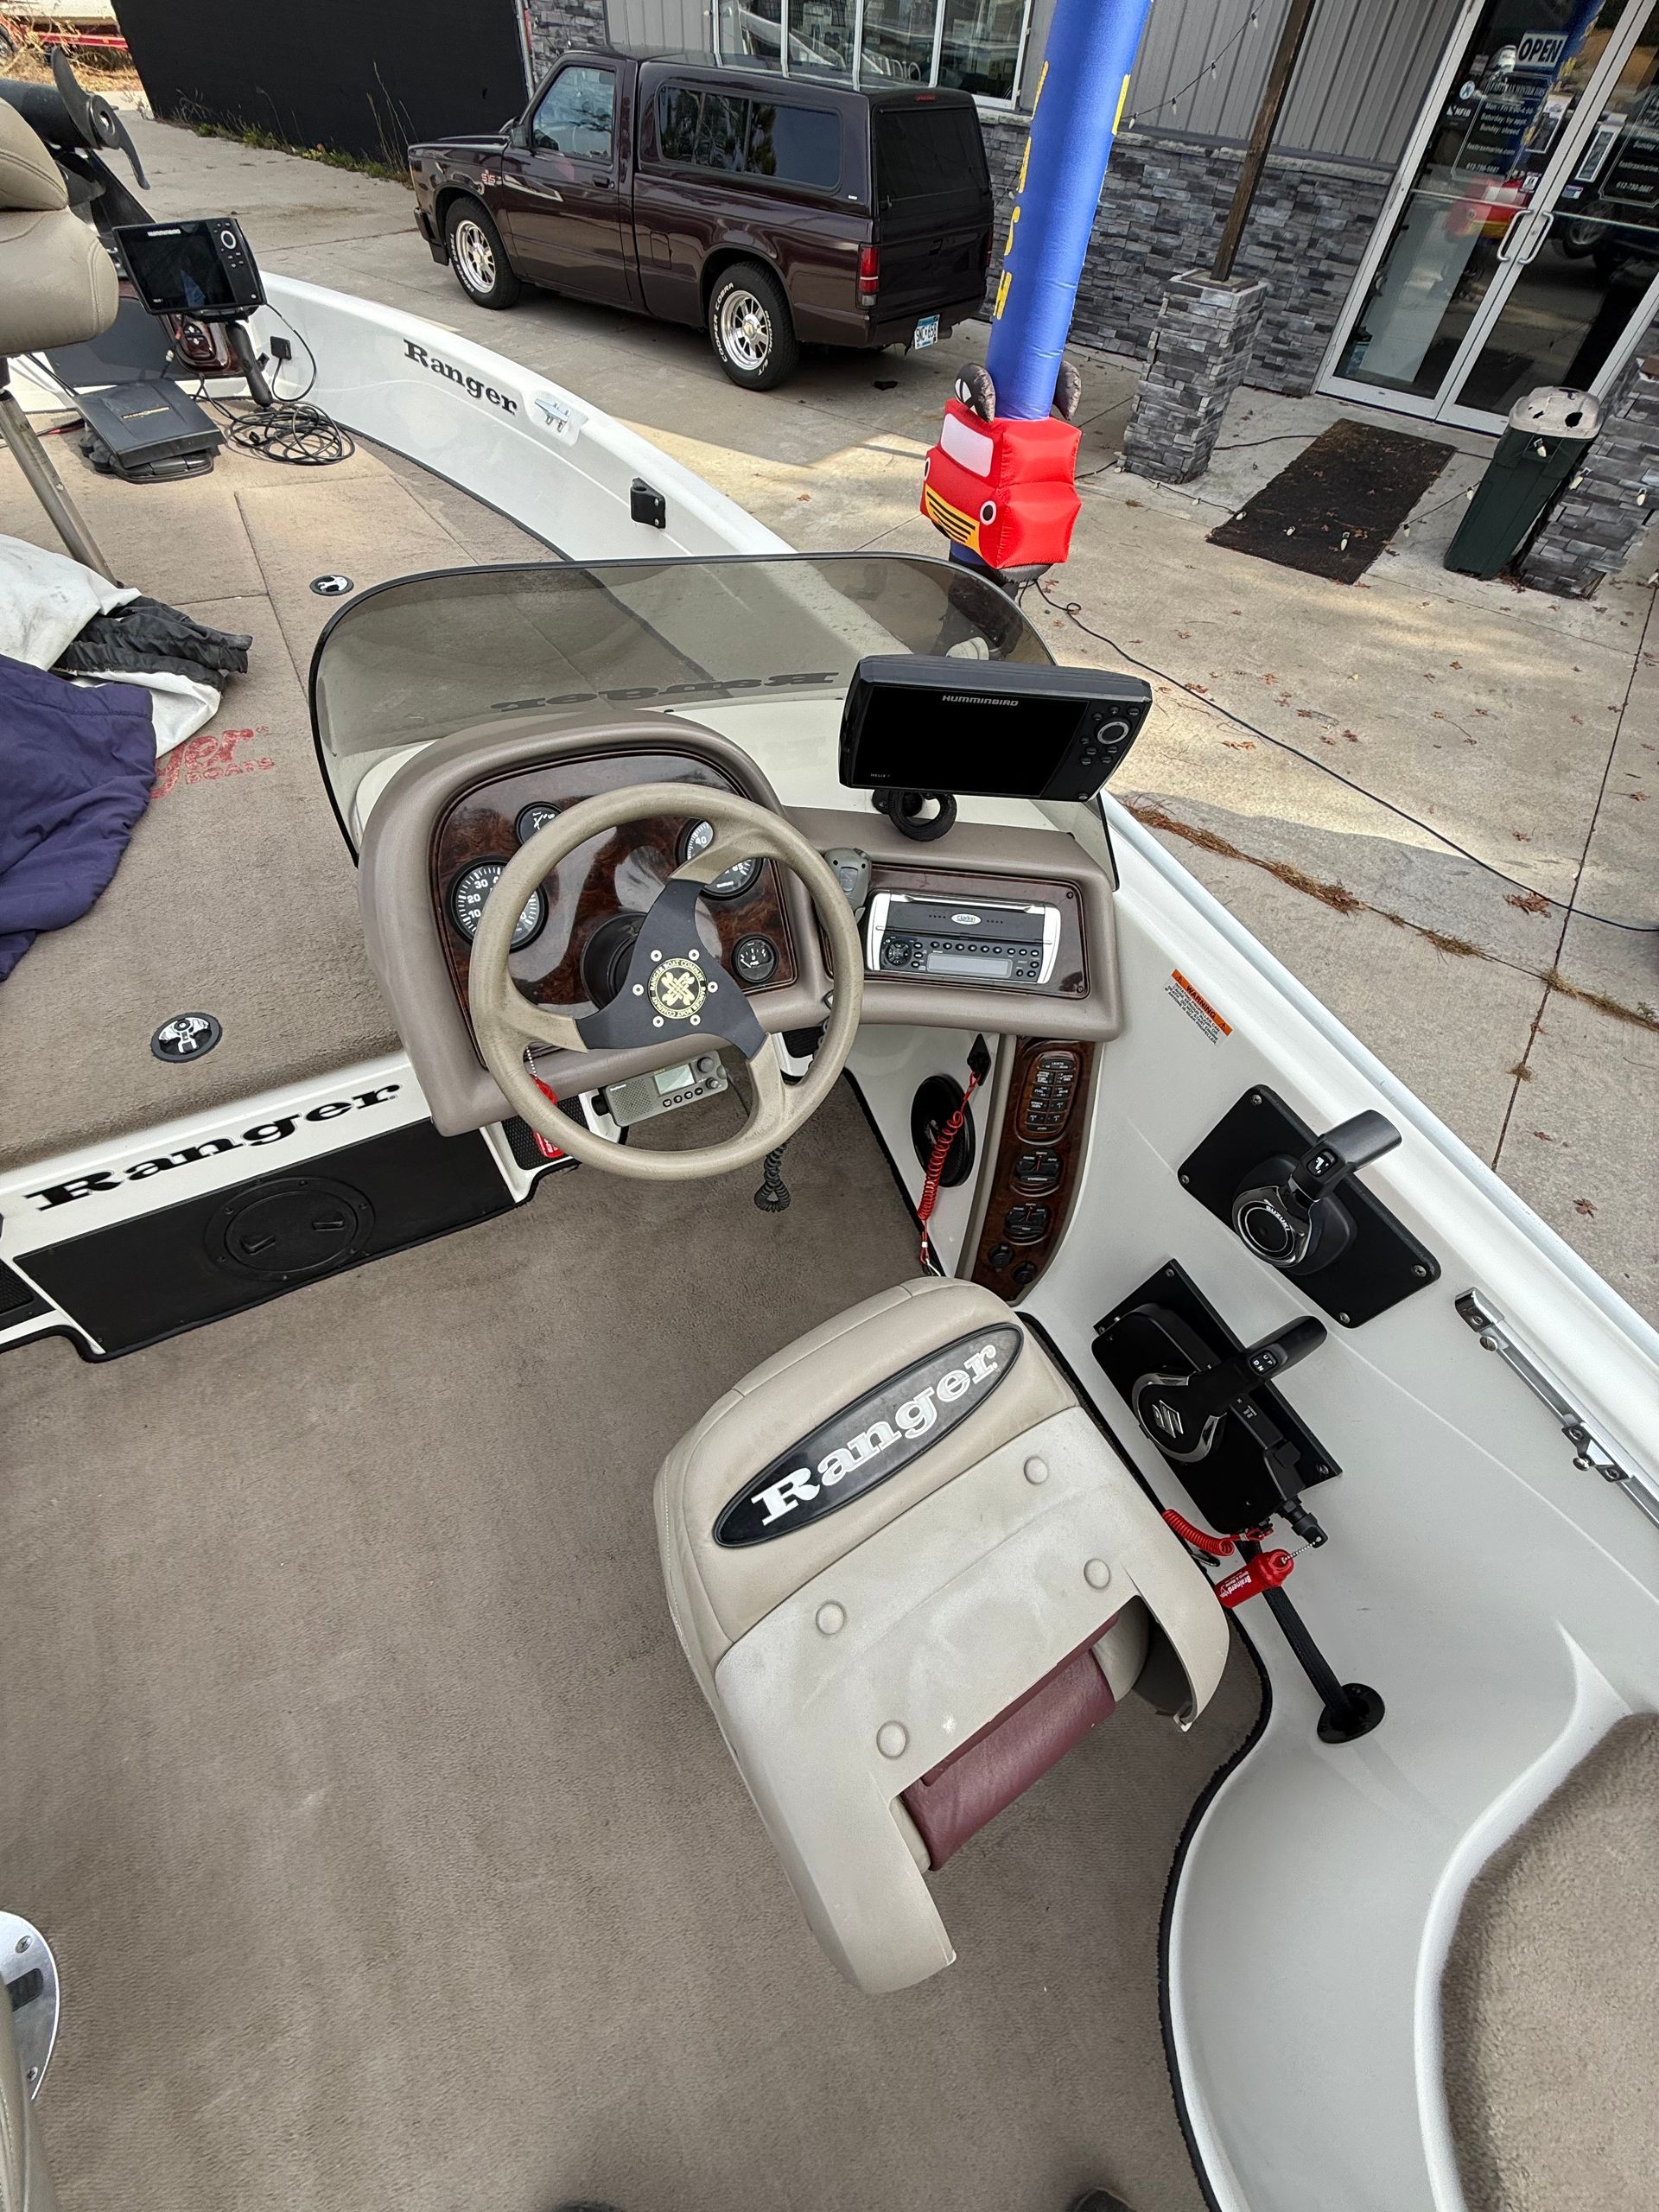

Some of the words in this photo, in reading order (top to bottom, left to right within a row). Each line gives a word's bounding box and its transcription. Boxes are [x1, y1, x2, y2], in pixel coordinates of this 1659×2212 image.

[1518, 37, 1563, 63] OPEN
[715, 282, 734, 311] COBRA
[714, 314, 728, 363] COOPER
[404, 338, 518, 416] Ranger
[942, 695, 1019, 706] HUMMINBIRD
[185, 757, 275, 785] BOATS
[696, 836, 707, 845] 40
[474, 879, 488, 889] 30
[467, 893, 480, 904] 20
[467, 908, 481, 918] 10
[650, 966, 664, 991] RANGER
[663, 960, 680, 969] BOAT
[680, 960, 705, 982] COMPANY
[651, 996, 676, 1017] COMPANY
[1186, 985, 1217, 1019] WARNING
[22, 1084, 402, 1211] Ranger
[1266, 1205, 1291, 1231] SUZUKI
[750, 1344, 999, 1527] Ranger
[1227, 1574, 1252, 1595] Brainerd
